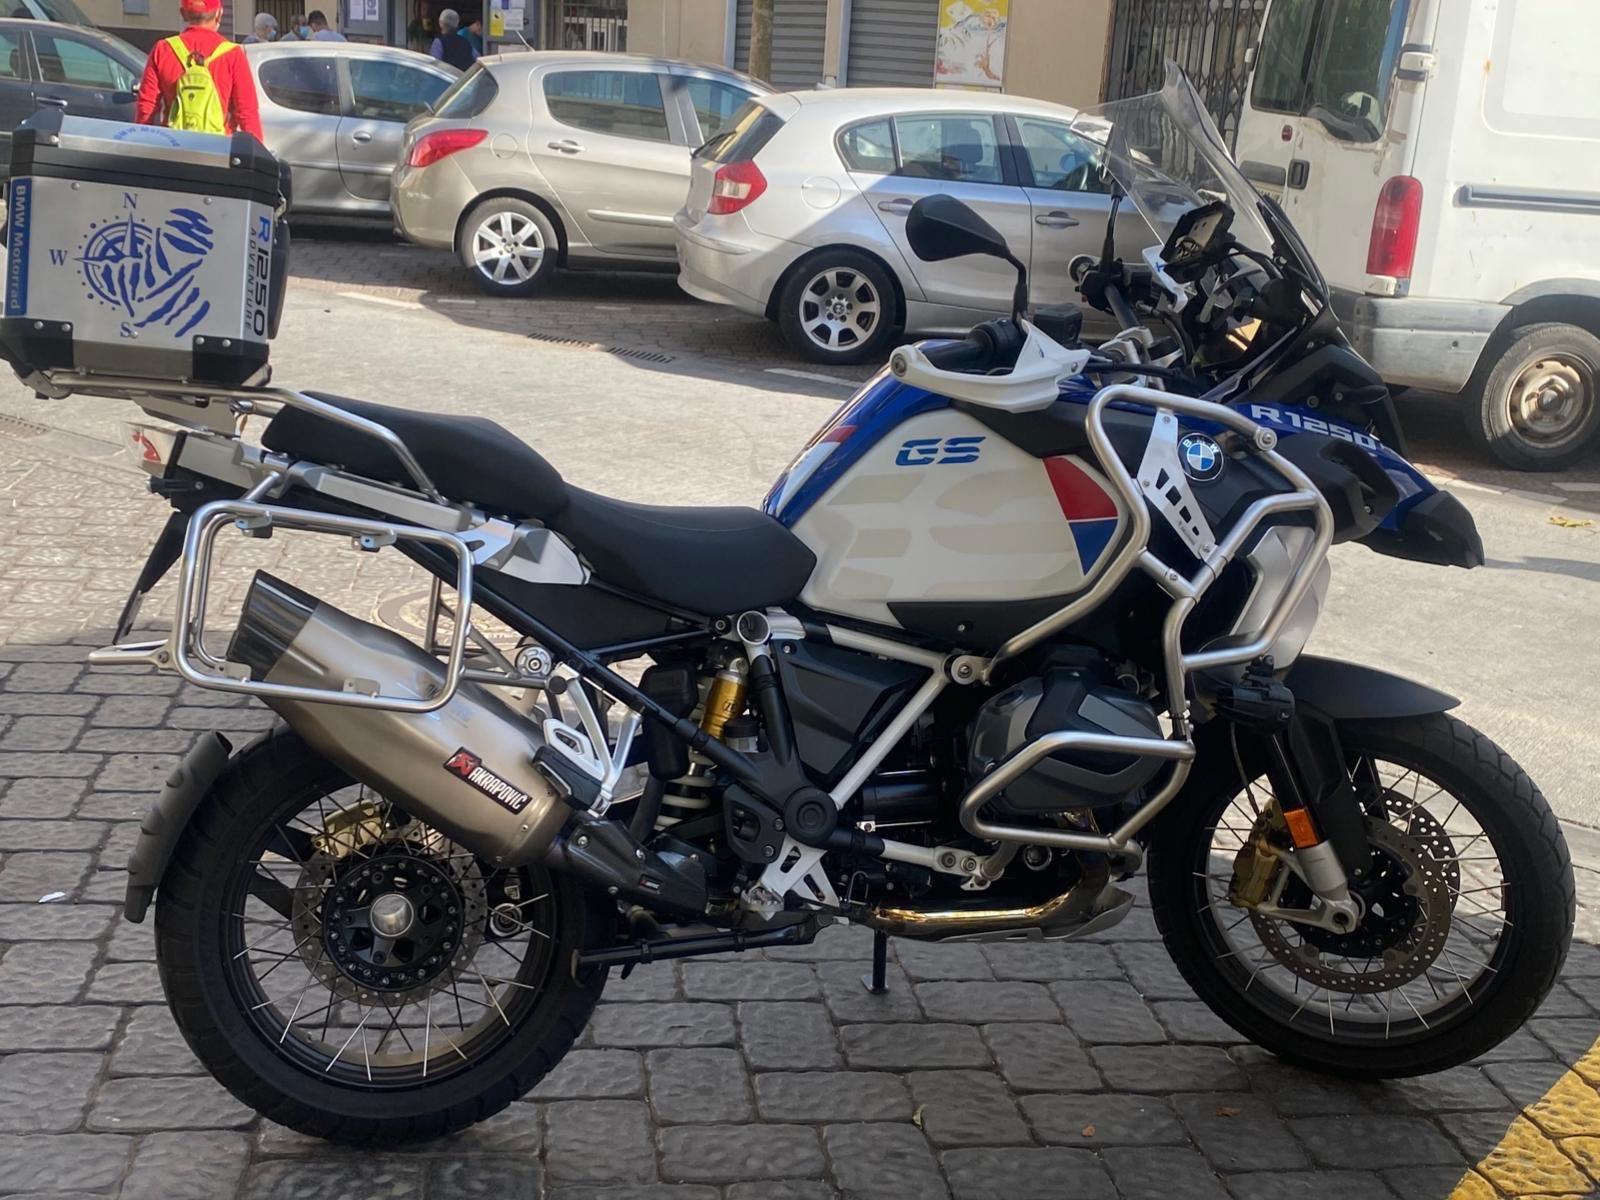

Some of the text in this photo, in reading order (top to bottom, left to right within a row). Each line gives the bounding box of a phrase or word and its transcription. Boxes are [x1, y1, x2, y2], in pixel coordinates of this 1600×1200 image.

[123, 191, 139, 209] N
[10, 184, 26, 309] BMW Motorrad
[49, 248, 68, 266] W
[243, 226, 257, 331] ADVENTURE
[895, 436, 987, 467] GS
